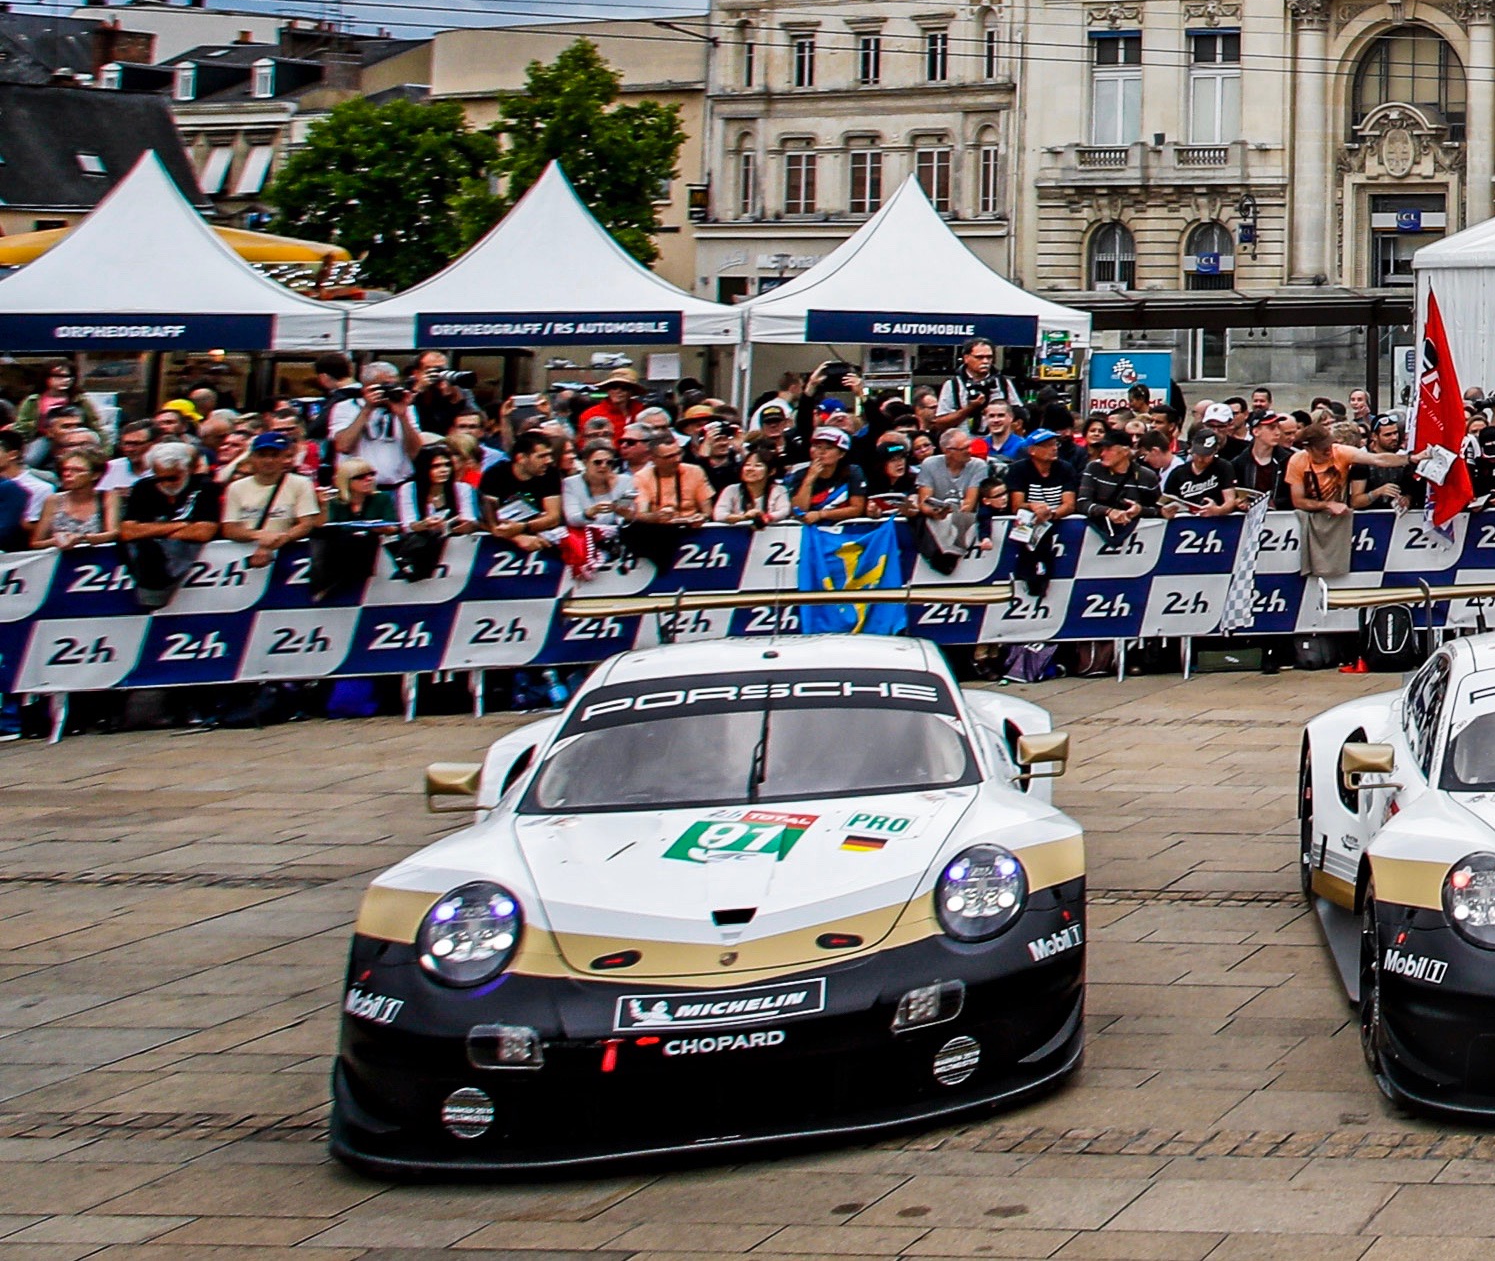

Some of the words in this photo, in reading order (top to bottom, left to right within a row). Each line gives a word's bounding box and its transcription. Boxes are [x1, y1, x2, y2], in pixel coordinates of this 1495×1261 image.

[1397, 212, 1417, 222] LCL
[55, 325, 186, 338] ORPHEOGRAFF
[430, 323, 543, 336] ORPHEOGRAFF
[553, 322, 575, 335] RS
[575, 321, 669, 334] AUTOMOBILE
[872, 322, 892, 334] RS
[892, 323, 975, 335] AUTOMOBILE
[1175, 529, 1223, 553] 24h
[487, 551, 546, 577] 24h
[674, 543, 730, 569] 24h
[65, 565, 136, 593] 24h
[184, 561, 249, 588] 24h
[918, 604, 969, 624] 24h
[1082, 594, 1130, 618] 24h
[1162, 591, 1209, 615] 24h
[267, 626, 331, 655] 24h
[368, 621, 432, 650] 24h
[469, 616, 529, 644] 24h
[564, 616, 623, 640] 24h
[46, 637, 116, 665] 24h
[157, 631, 227, 661] 24h
[581, 681, 939, 722] PORSCHE
[749, 813, 812, 825] TOTAL
[847, 813, 911, 833] PRO
[688, 822, 787, 864] 91
[1028, 929, 1074, 962] Mobil
[1384, 949, 1427, 979] Mobil
[1424, 959, 1448, 984] 1
[345, 989, 385, 1022] Mobil
[674, 991, 807, 1018] MICHELIN
[663, 1030, 785, 1056] CHOPARD
